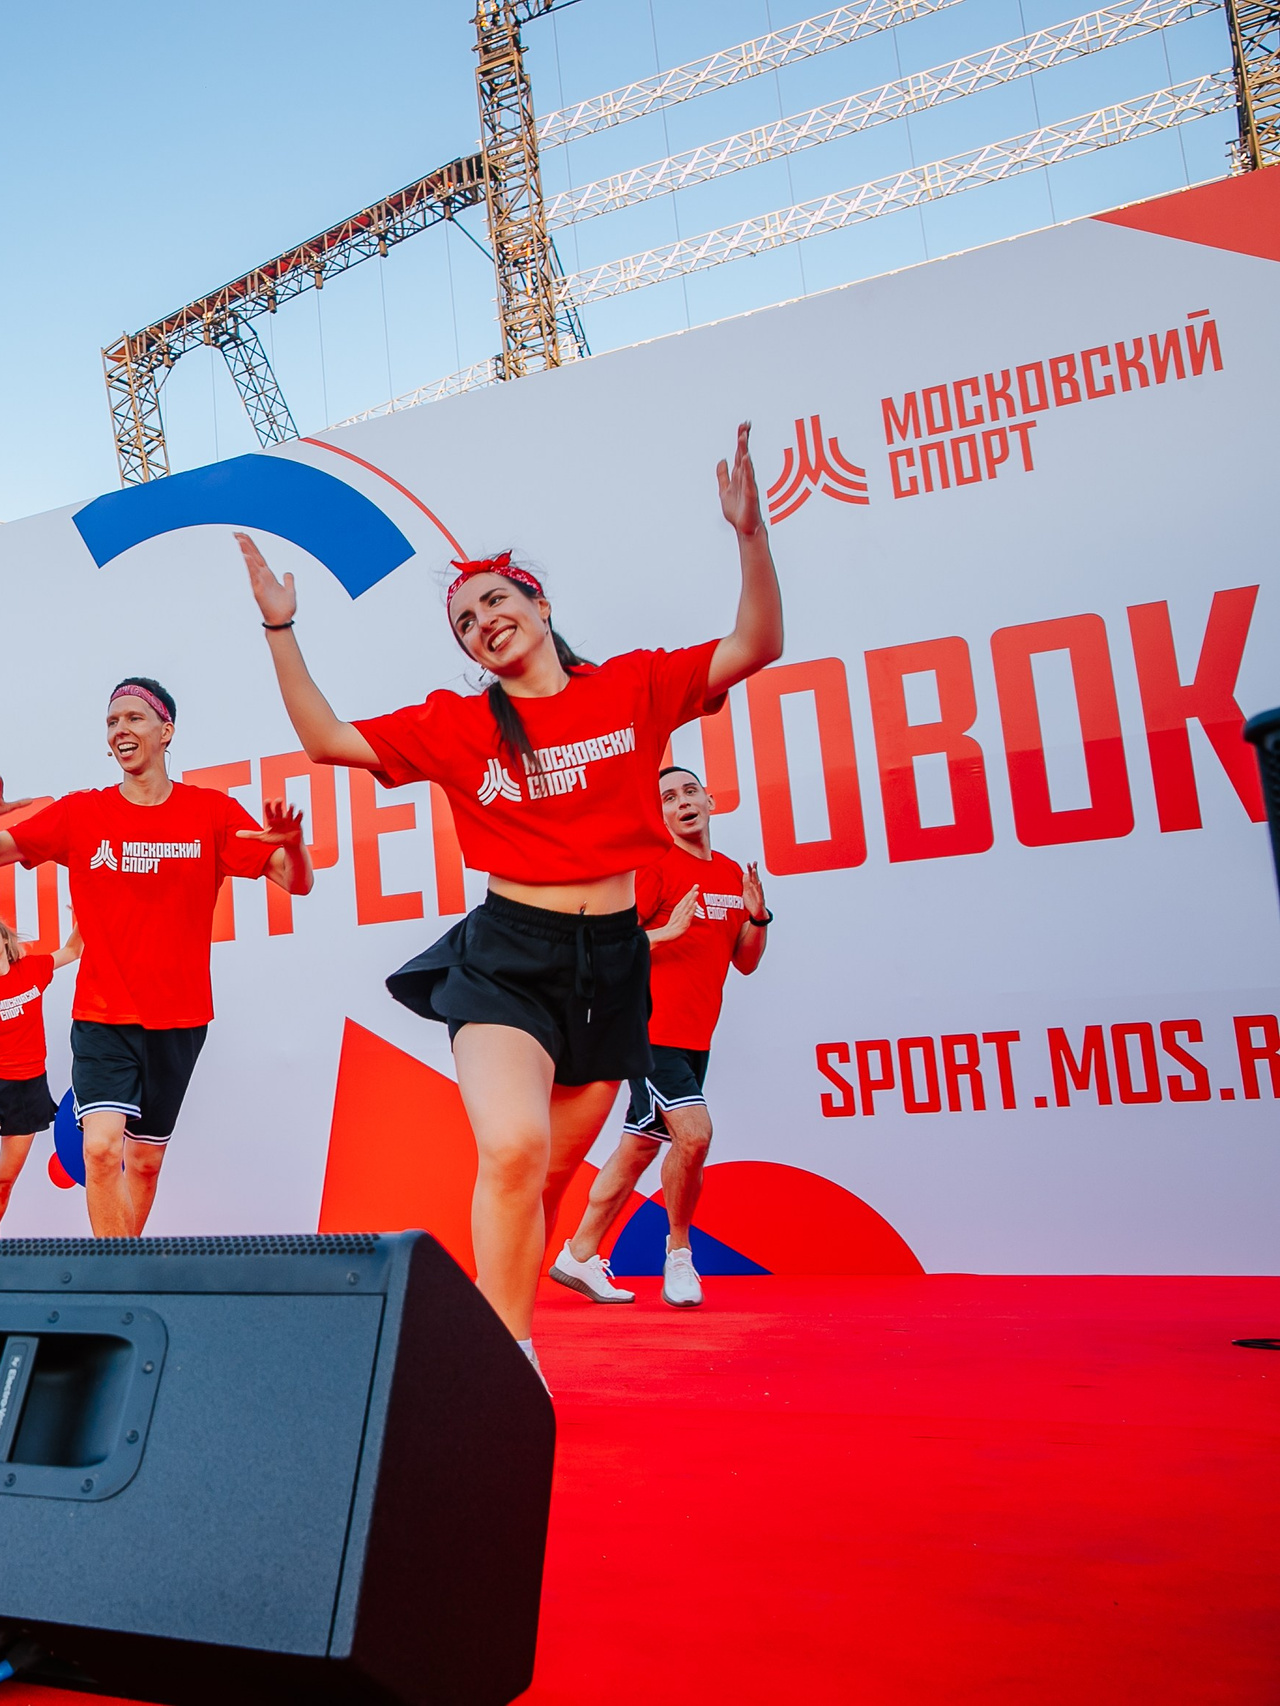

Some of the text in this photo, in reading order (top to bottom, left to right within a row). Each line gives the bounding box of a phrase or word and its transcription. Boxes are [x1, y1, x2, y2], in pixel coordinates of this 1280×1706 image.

[880, 308, 1224, 446] МОСКОВСКИЙ
[888, 419, 1038, 500] СПОРТ
[526, 765, 588, 800] СПОРТ
[121, 857, 160, 874] СПОРТ
[122, 839, 201, 858] МОСКОВСКИЙ
[0, 1005, 24, 1021] СПОРТ
[815, 1014, 1280, 1118] SPORT.MOS.R
